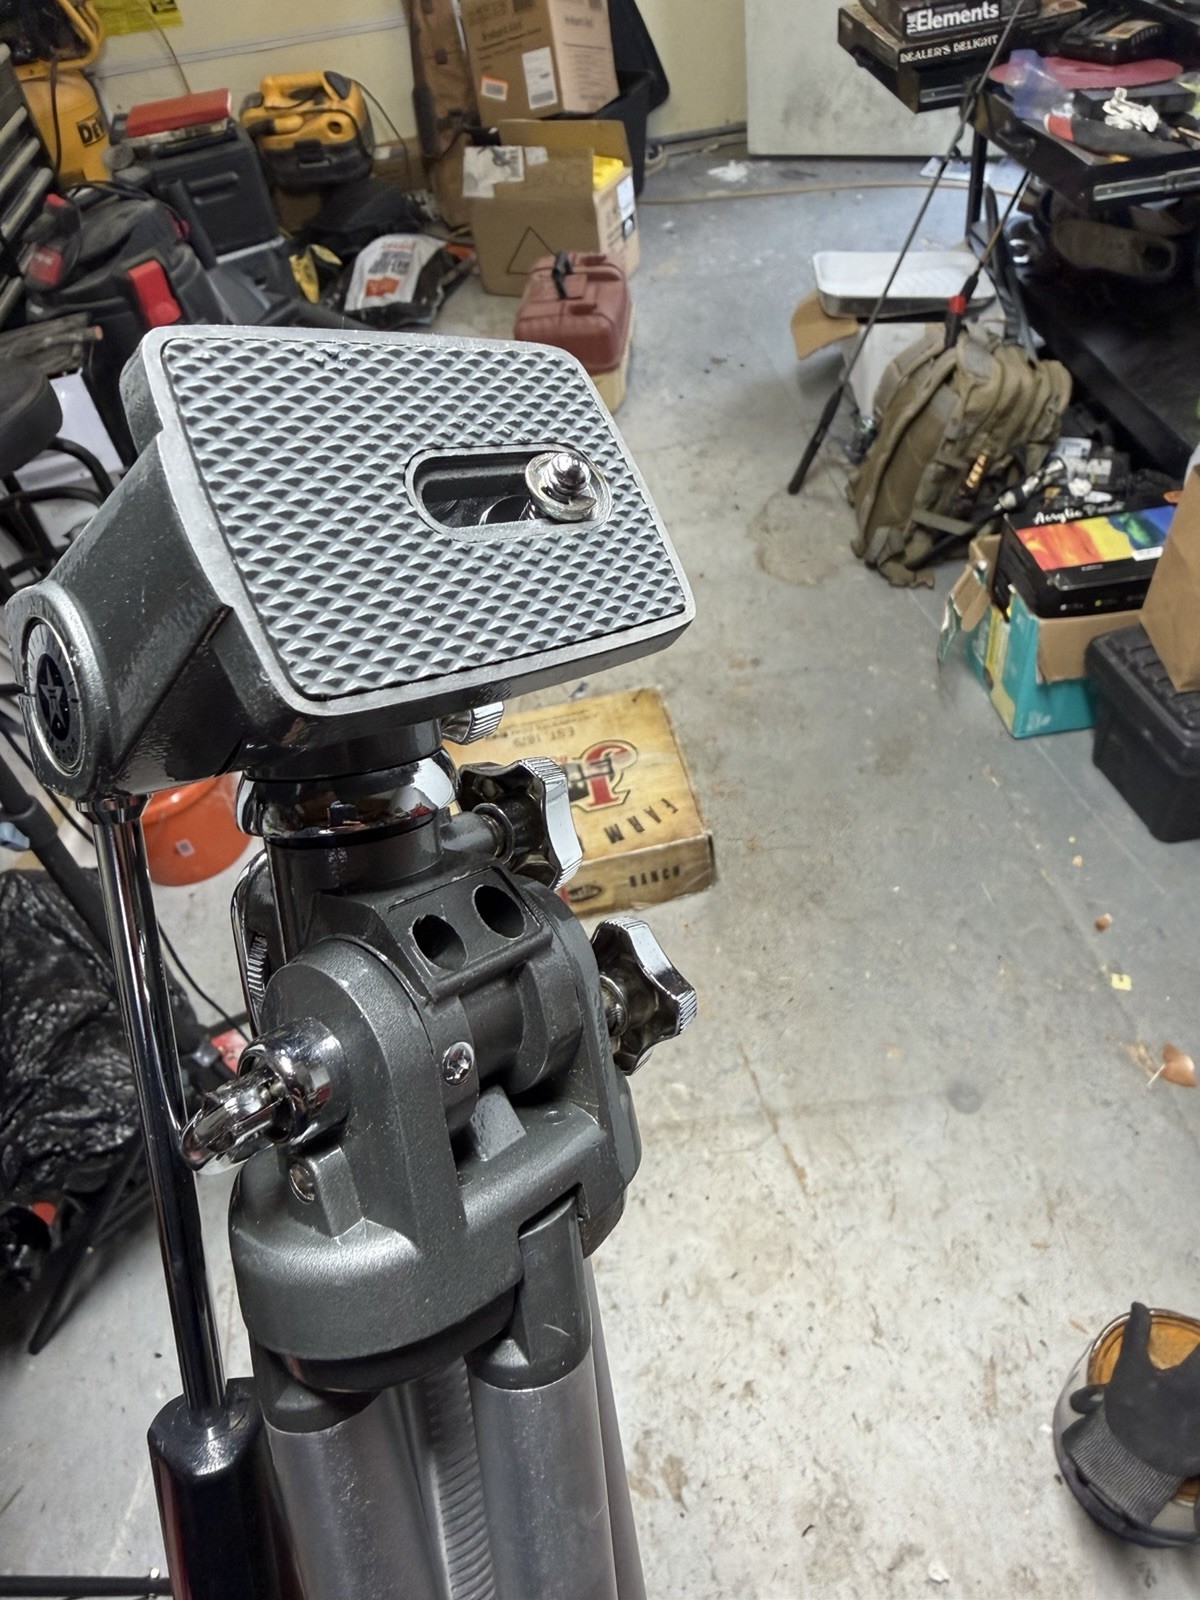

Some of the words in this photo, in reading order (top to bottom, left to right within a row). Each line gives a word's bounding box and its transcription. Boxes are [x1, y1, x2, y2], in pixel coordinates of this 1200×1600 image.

[917, 1, 1000, 32] Elements
[953, 35, 999, 53] DELIGHT
[1033, 507, 1083, 525] Acrylic
[604, 797, 679, 844] FARM
